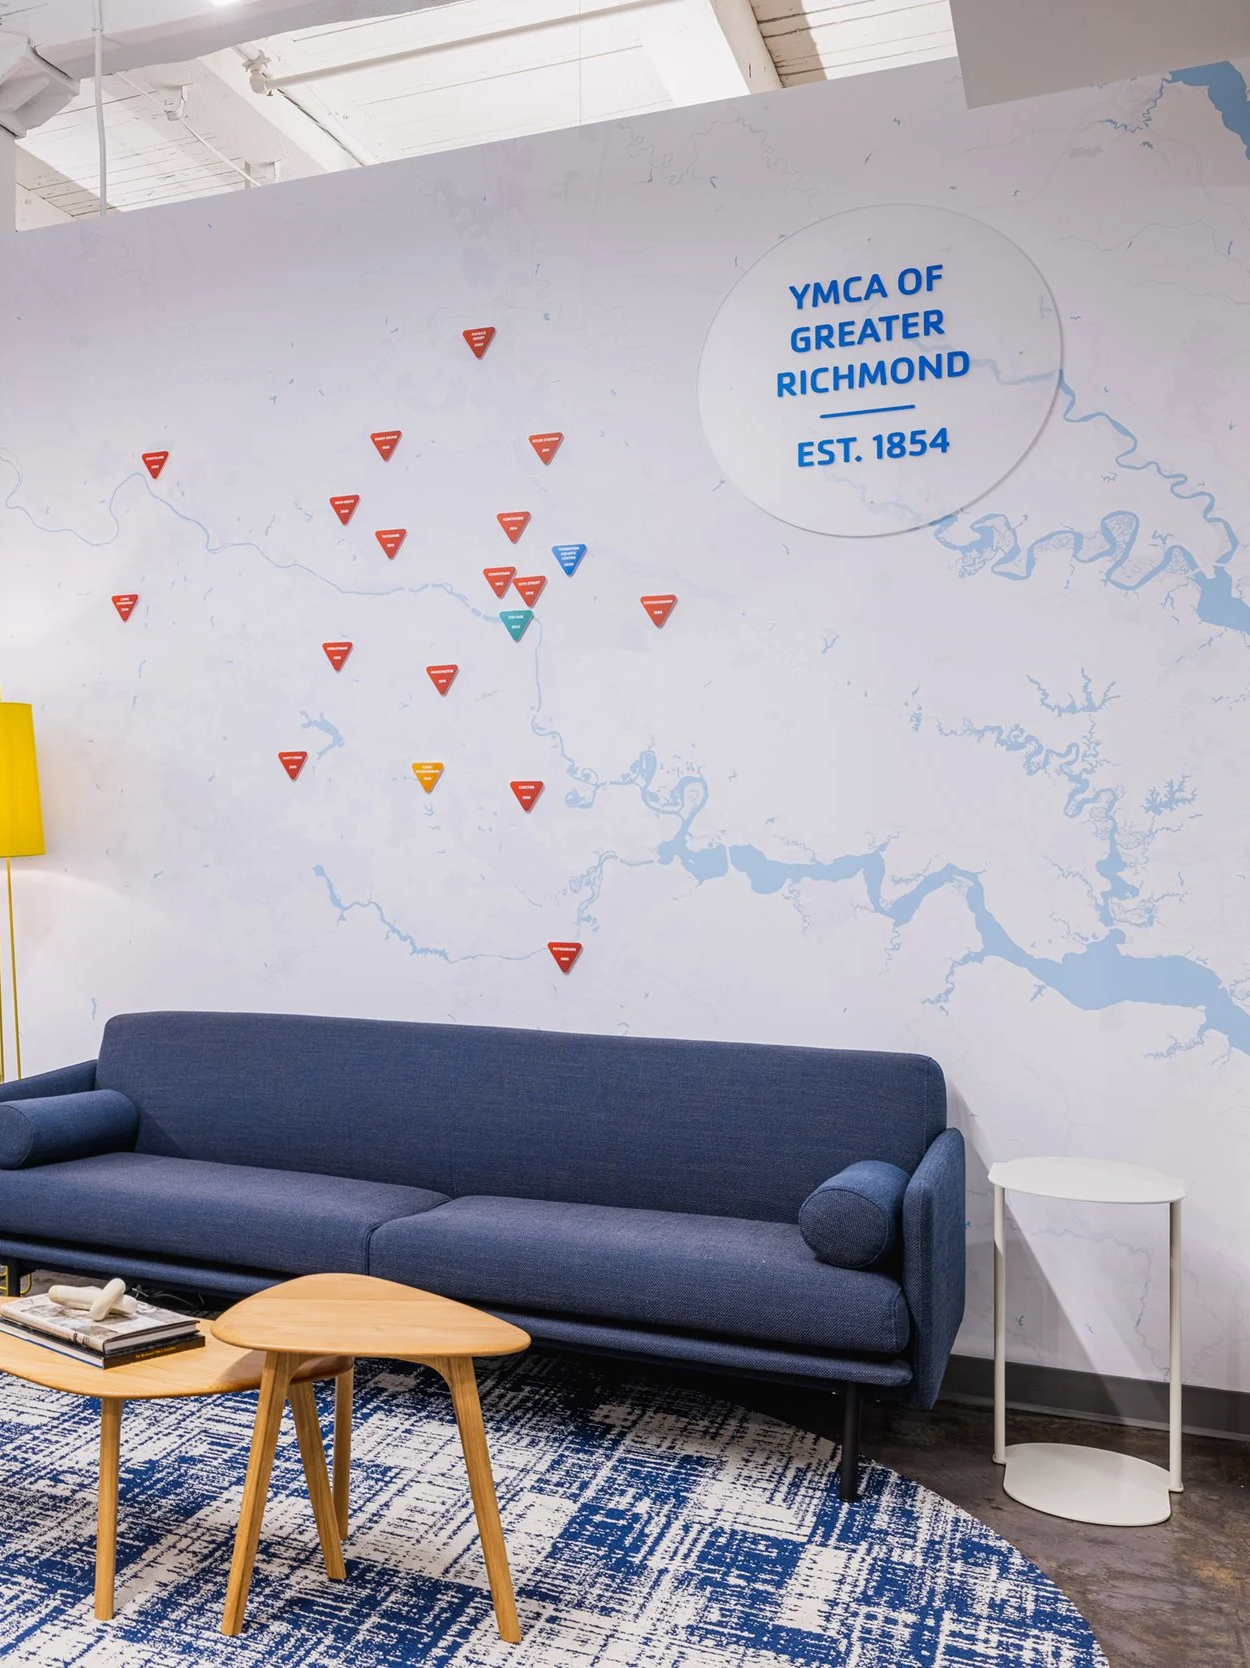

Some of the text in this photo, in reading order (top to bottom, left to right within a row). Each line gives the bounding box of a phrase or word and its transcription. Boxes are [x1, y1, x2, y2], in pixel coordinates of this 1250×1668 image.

[789, 264, 942, 310] YMCA OF
[791, 309, 945, 353] GREATER
[776, 351, 971, 398] RICHMOND
[798, 427, 949, 467] EST. 1854
